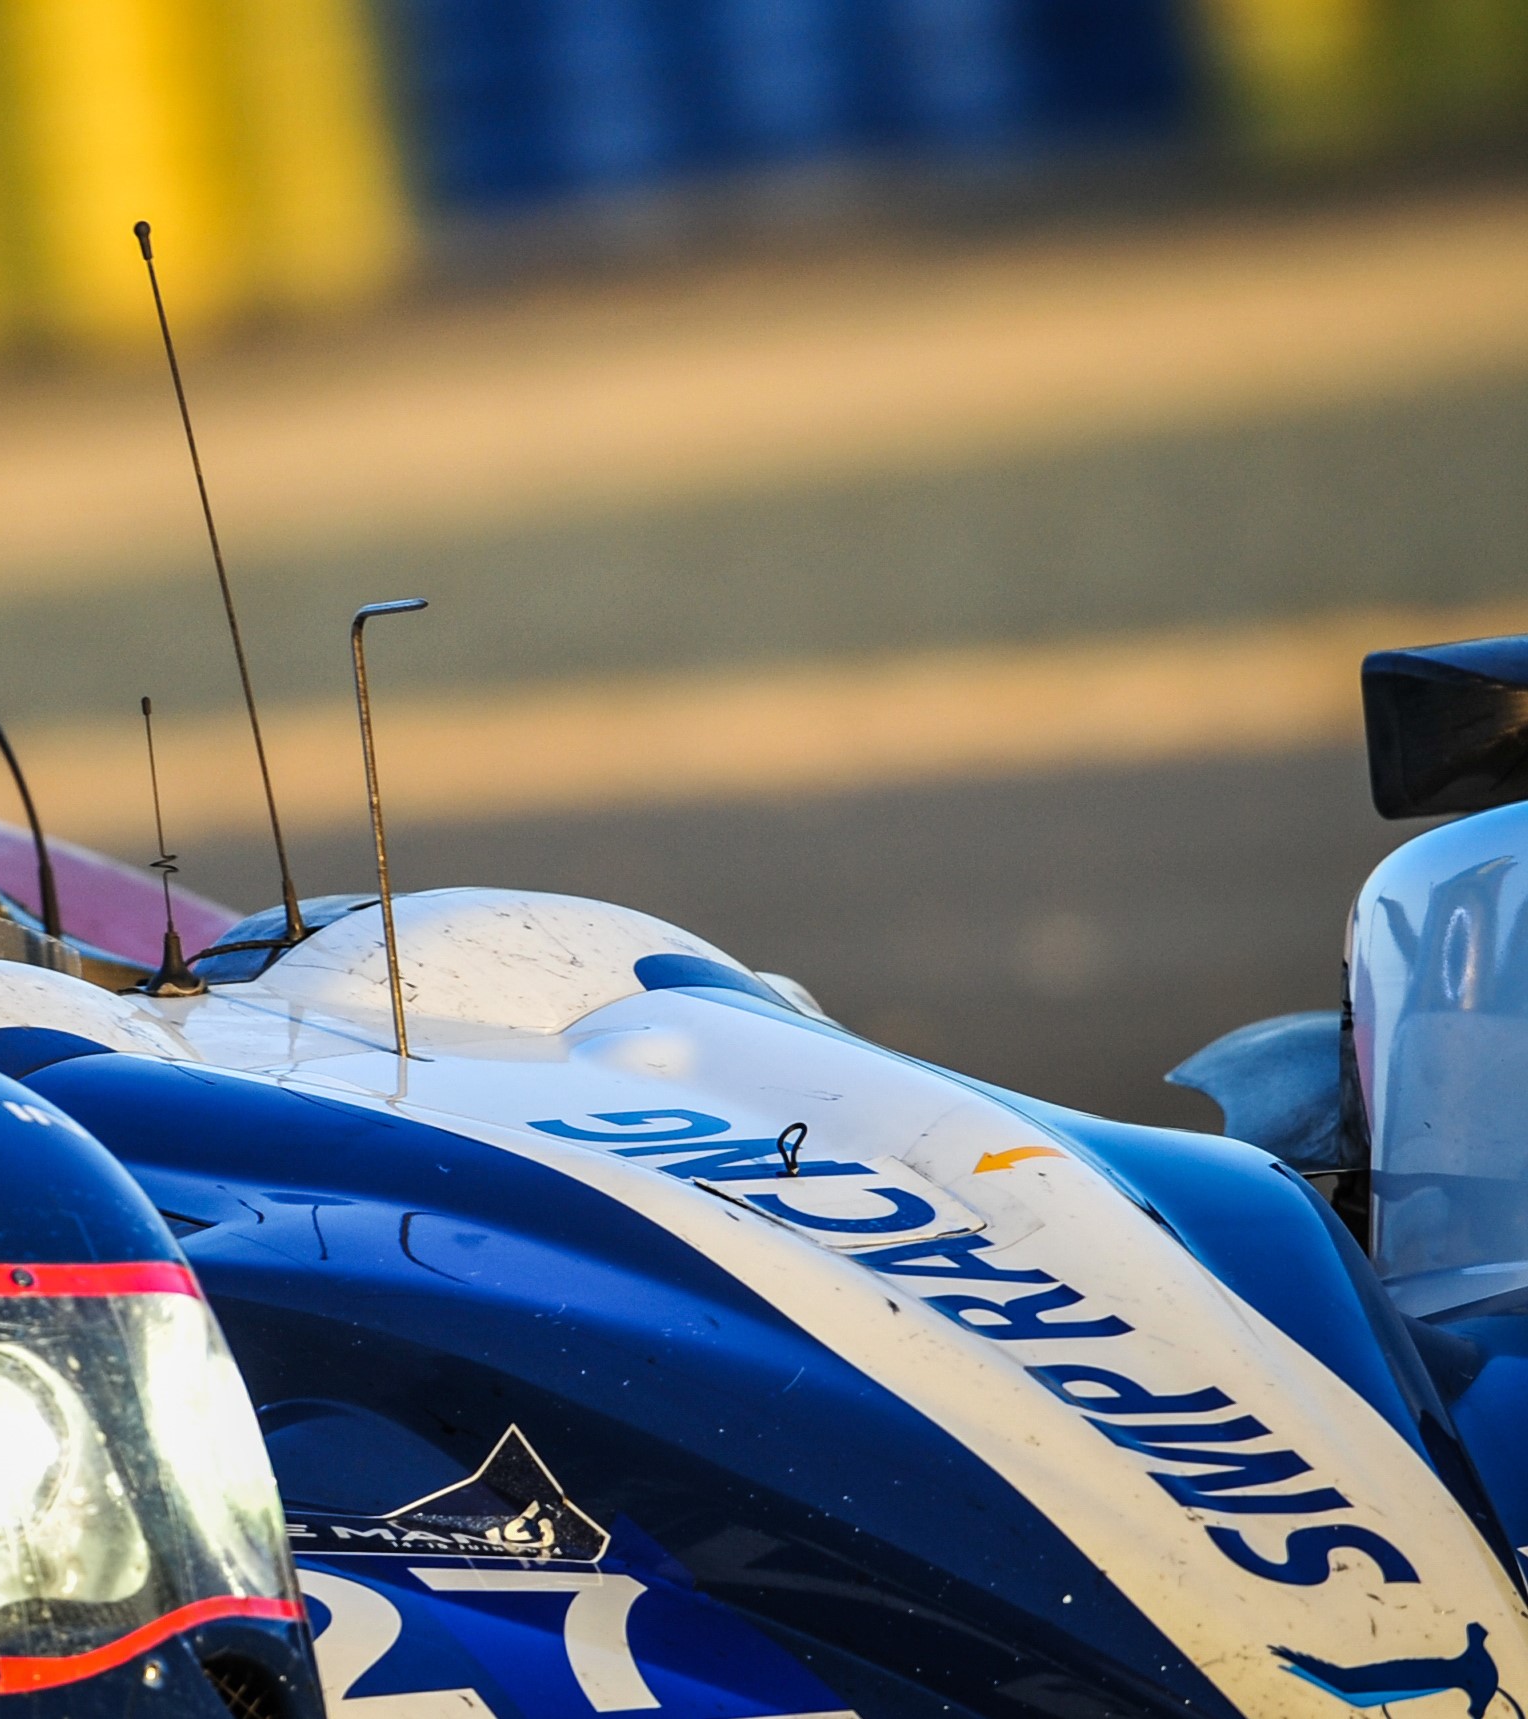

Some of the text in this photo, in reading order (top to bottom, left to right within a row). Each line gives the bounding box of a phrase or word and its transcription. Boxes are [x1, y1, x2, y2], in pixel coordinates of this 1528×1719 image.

[526, 1108, 1421, 1586] SMP RACING
[295, 1567, 662, 1719] 27
